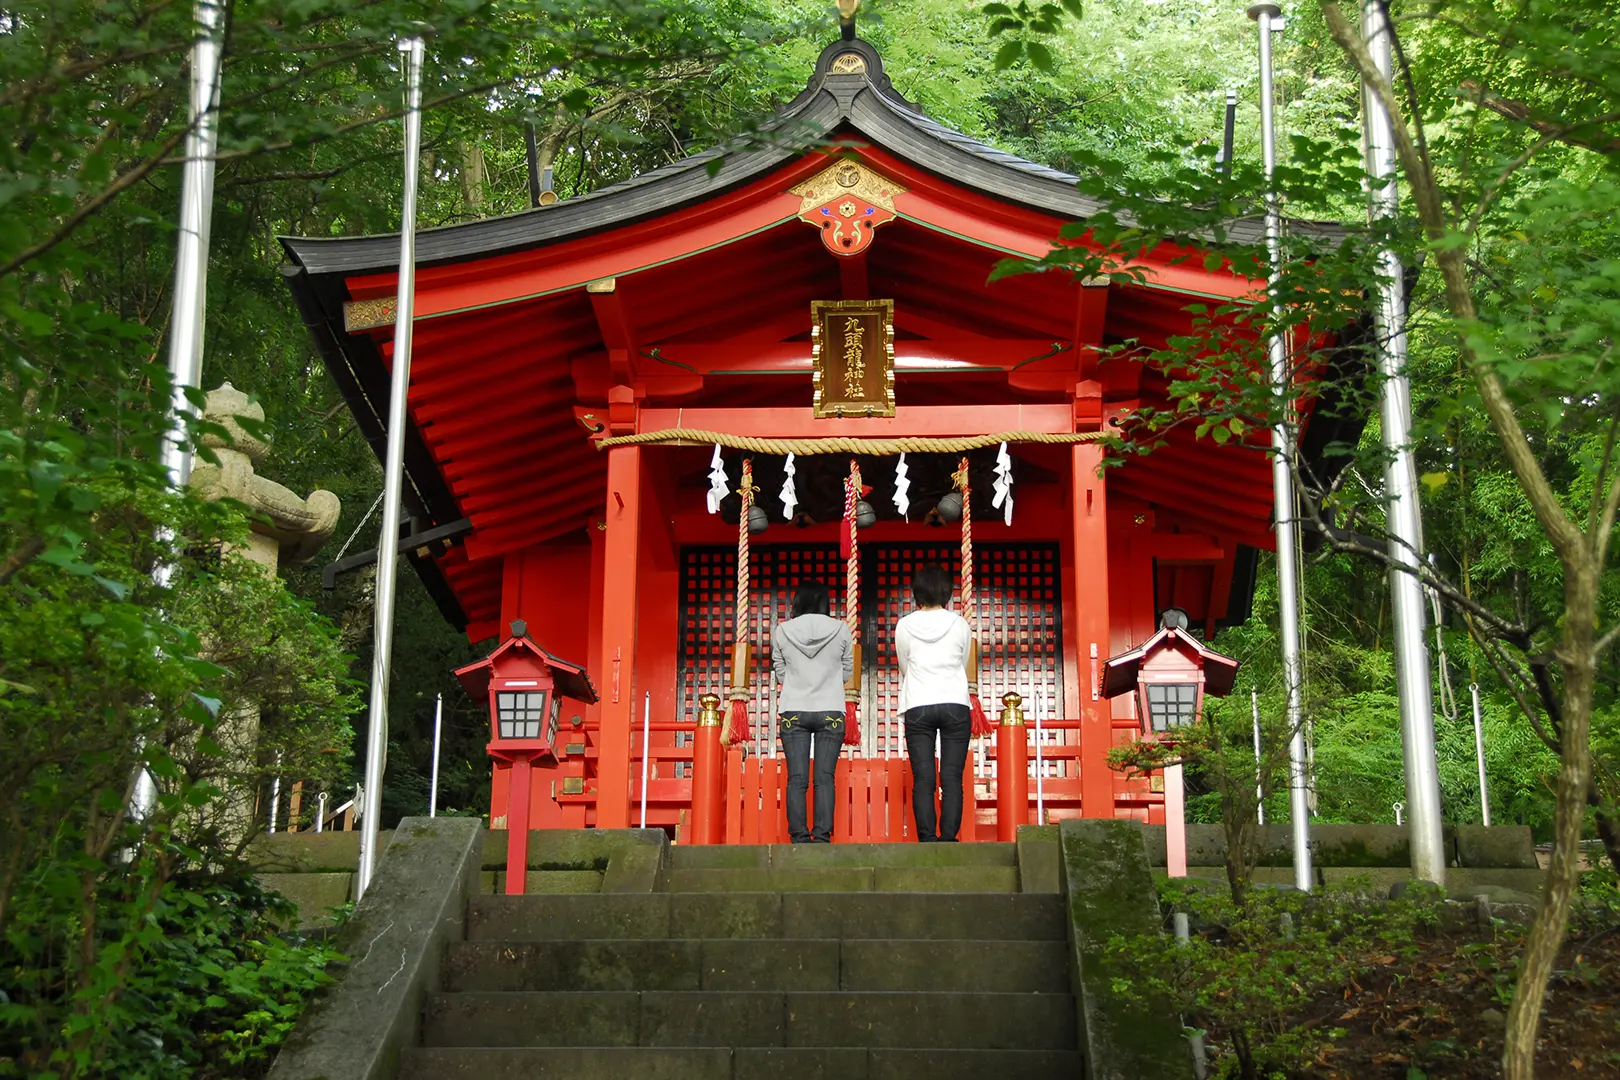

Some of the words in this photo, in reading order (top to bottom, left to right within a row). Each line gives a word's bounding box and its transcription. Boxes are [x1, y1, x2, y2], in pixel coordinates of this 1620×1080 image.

[843, 316, 866, 398] 九頭龍神社
